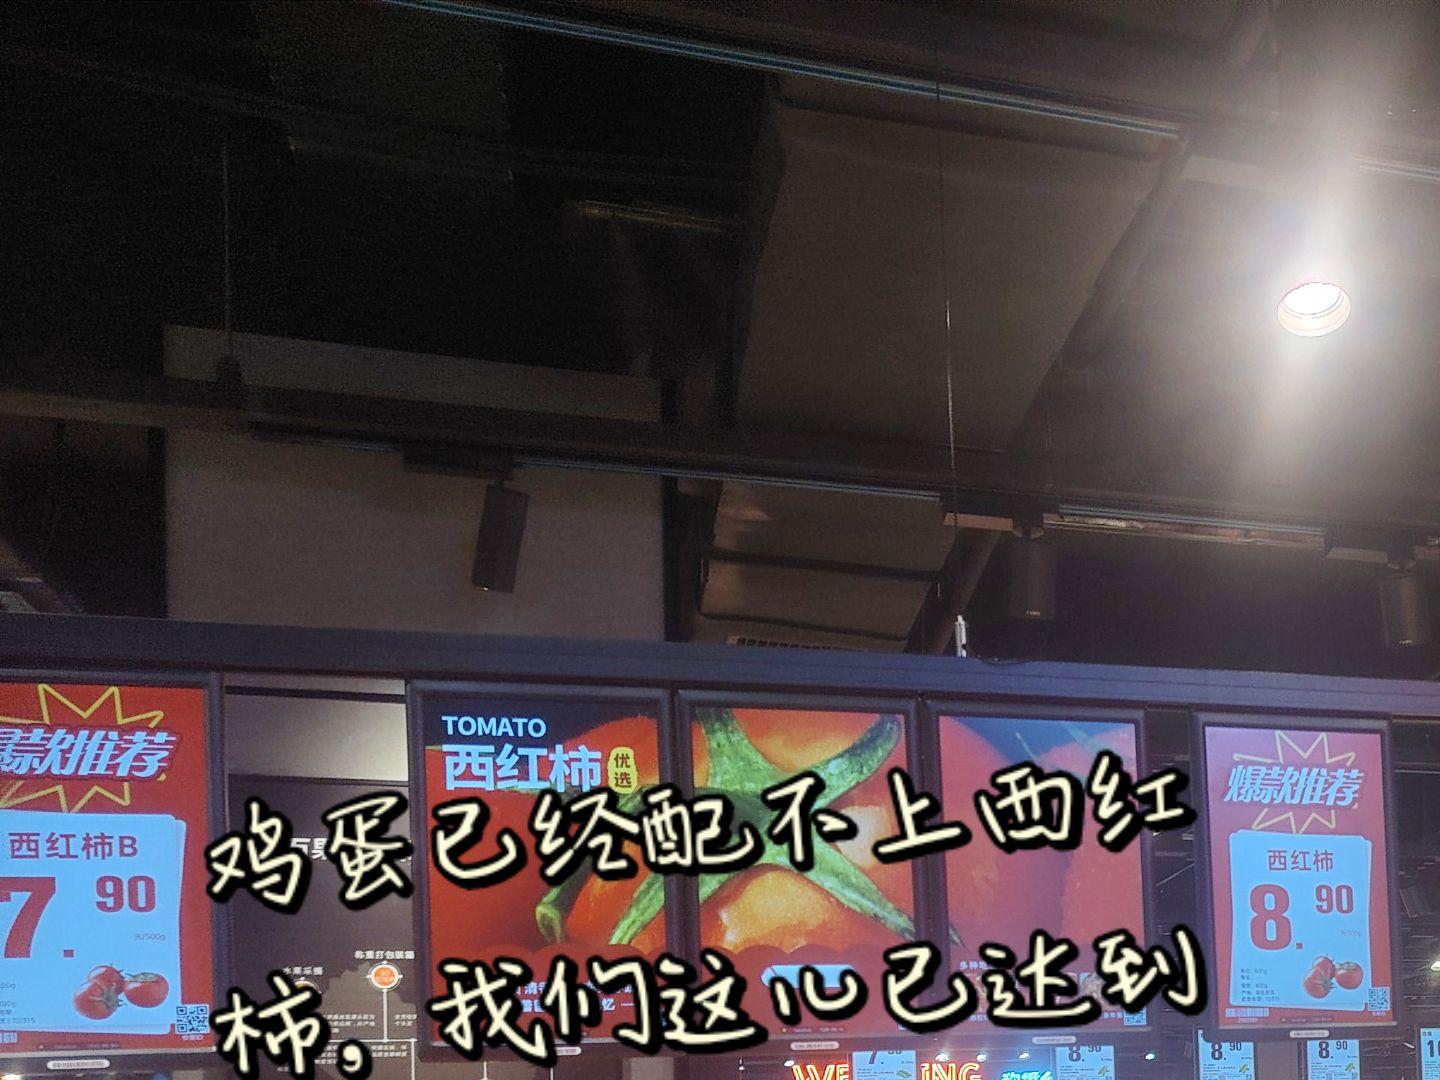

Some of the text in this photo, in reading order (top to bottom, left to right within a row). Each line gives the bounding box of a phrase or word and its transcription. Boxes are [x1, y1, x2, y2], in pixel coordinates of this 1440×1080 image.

[442, 715, 547, 738] TOMATO
[442, 743, 602, 793] 西红柿
[613, 752, 632, 789] 优选
[1224, 765, 1365, 807] 爆款推荐
[8, 832, 138, 859] 西红柿B
[1267, 850, 1333, 872] 西红柿
[95, 875, 156, 913] 90
[1315, 884, 1354, 914] 90
